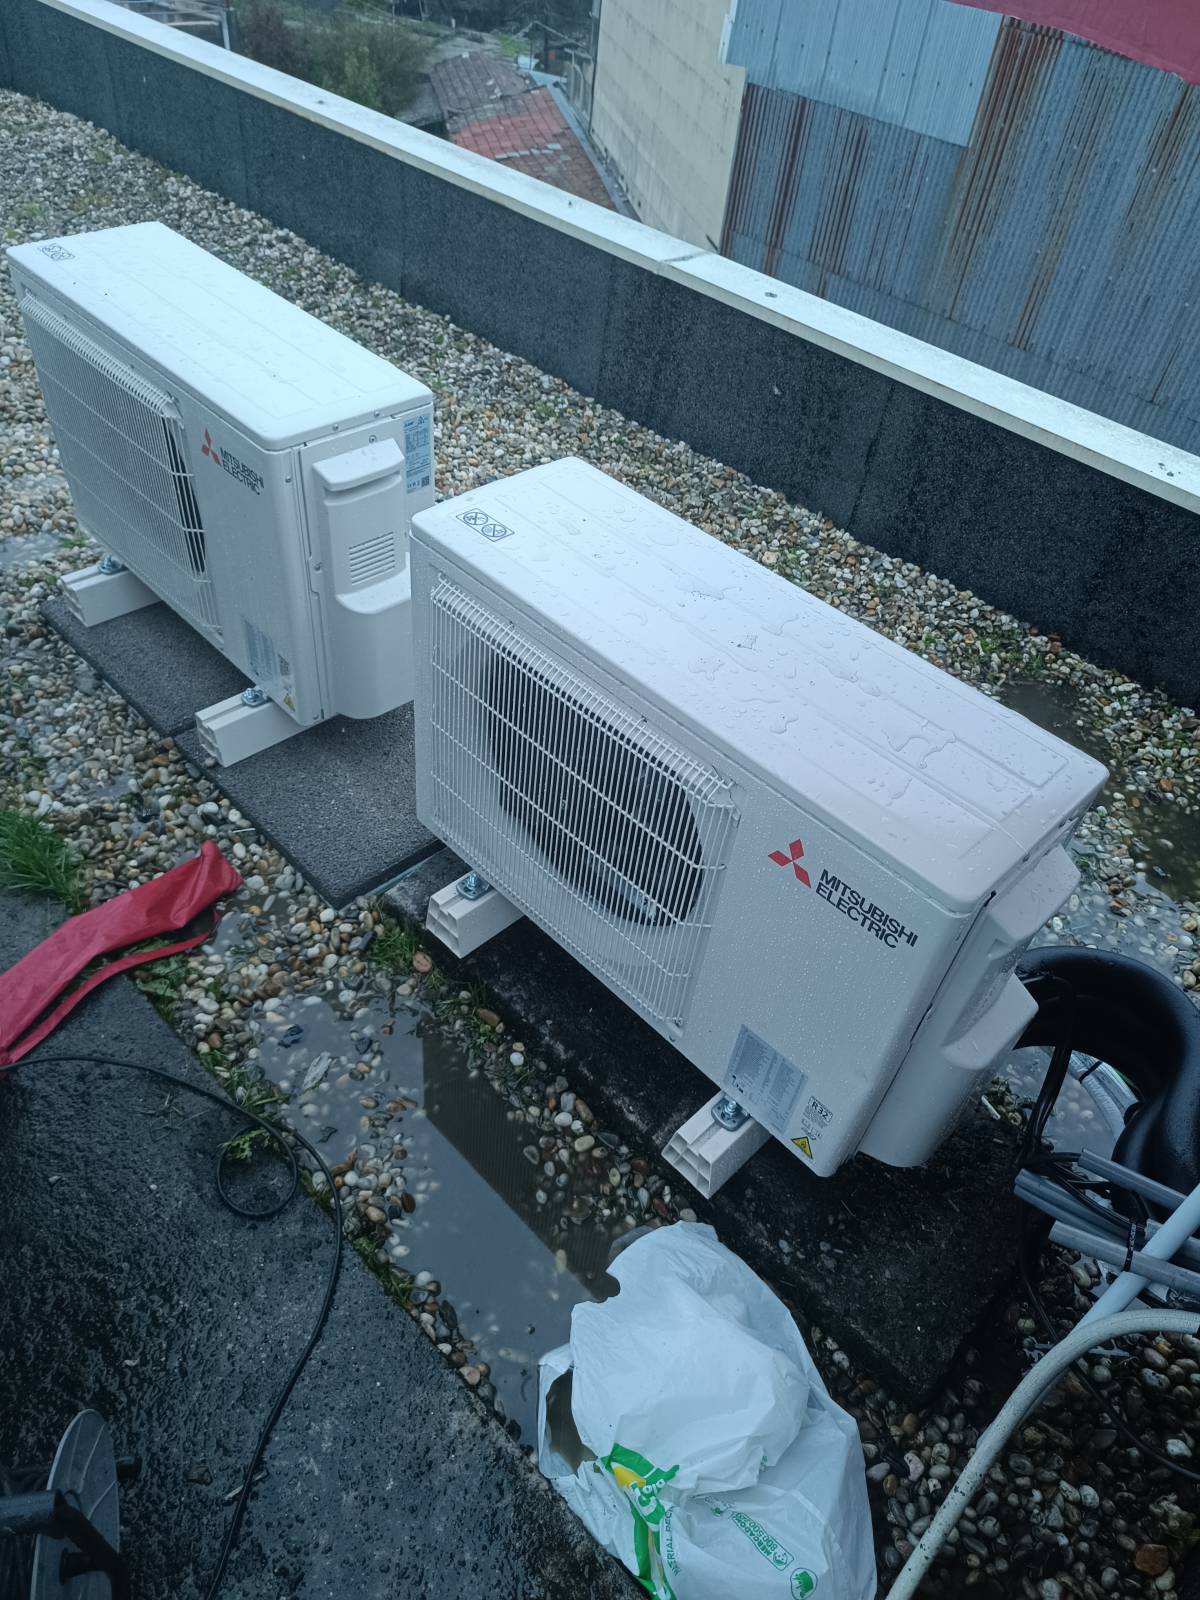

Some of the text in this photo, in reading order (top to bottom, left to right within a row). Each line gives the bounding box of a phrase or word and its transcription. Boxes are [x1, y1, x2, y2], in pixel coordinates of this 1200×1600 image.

[220, 447, 264, 488] MITSUBISHI
[222, 459, 260, 495] ELECTRIC
[816, 881, 899, 948] ELECTRIC
[820, 868, 918, 947] MITSUBISHI
[811, 1101, 828, 1119] R32
